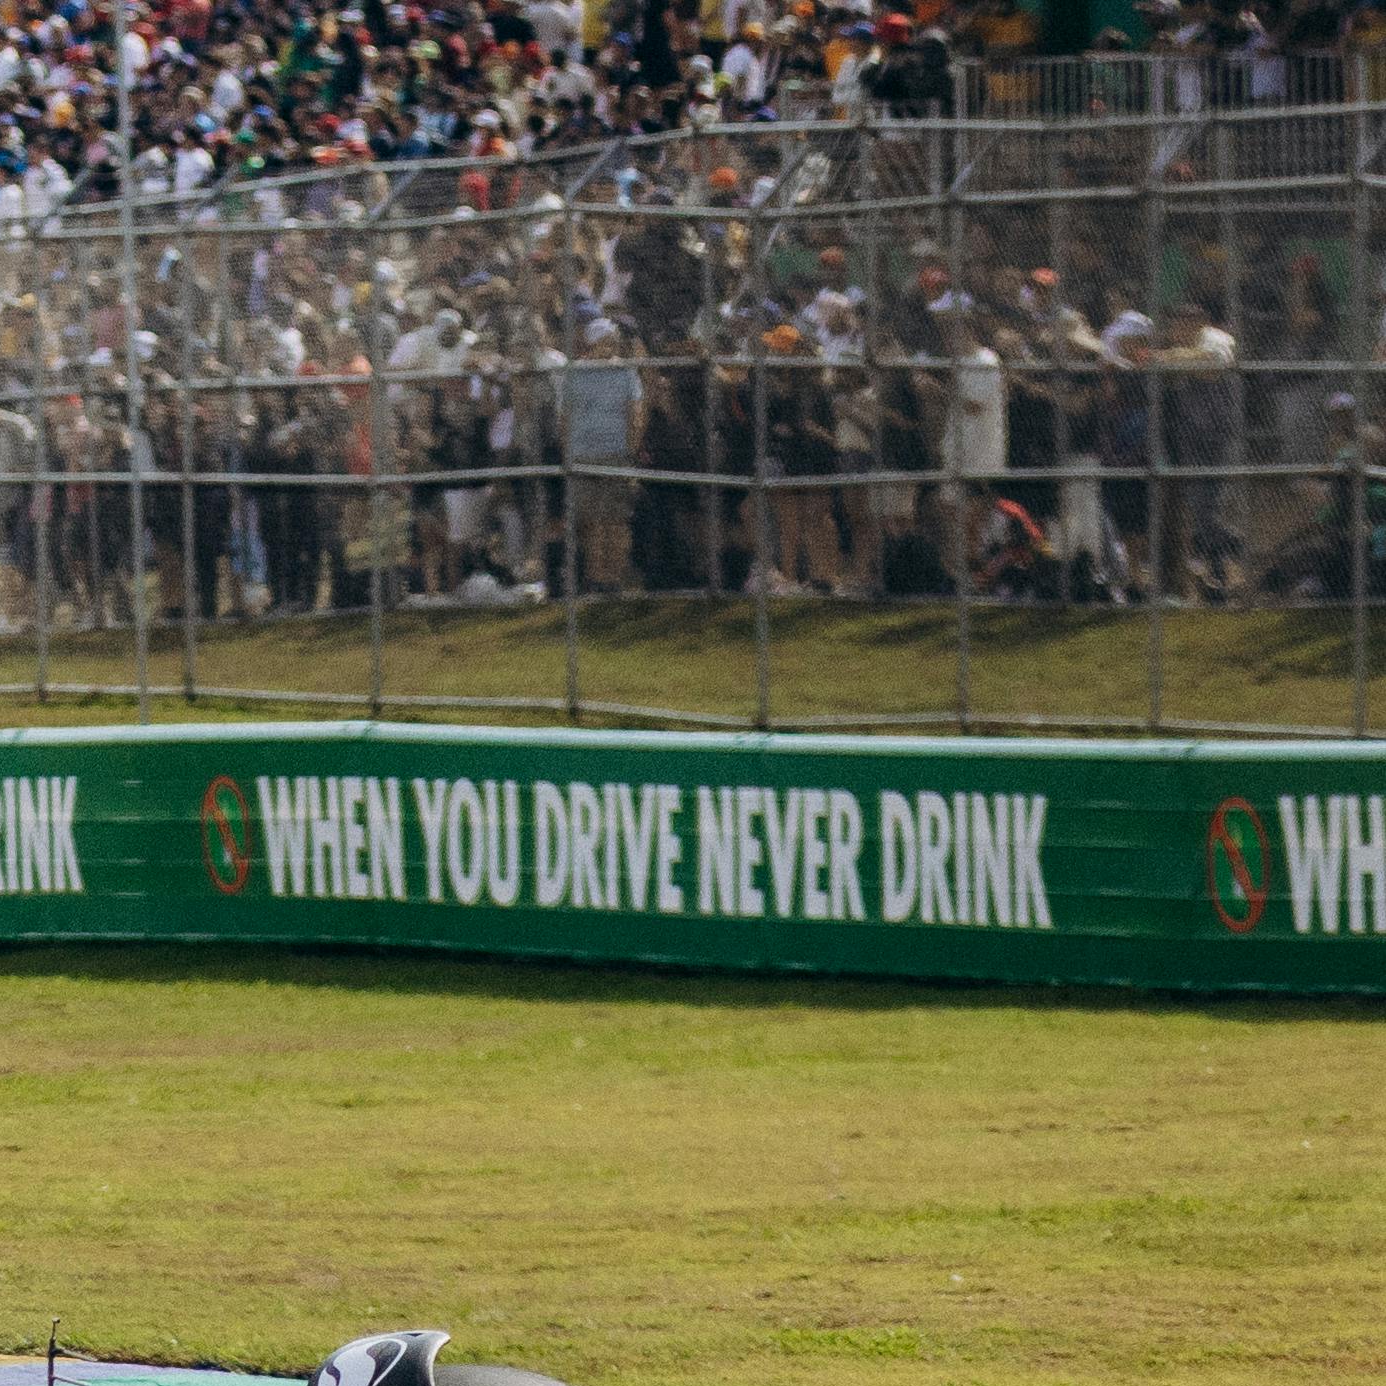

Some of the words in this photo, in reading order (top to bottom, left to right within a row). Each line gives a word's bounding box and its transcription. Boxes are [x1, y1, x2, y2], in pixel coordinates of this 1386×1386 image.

[255, 775, 406, 900] WHEN
[411, 776, 522, 908] YOU
[533, 779, 683, 914] DRIVE
[697, 784, 867, 921] NEVER
[880, 790, 1053, 929] DRINK
